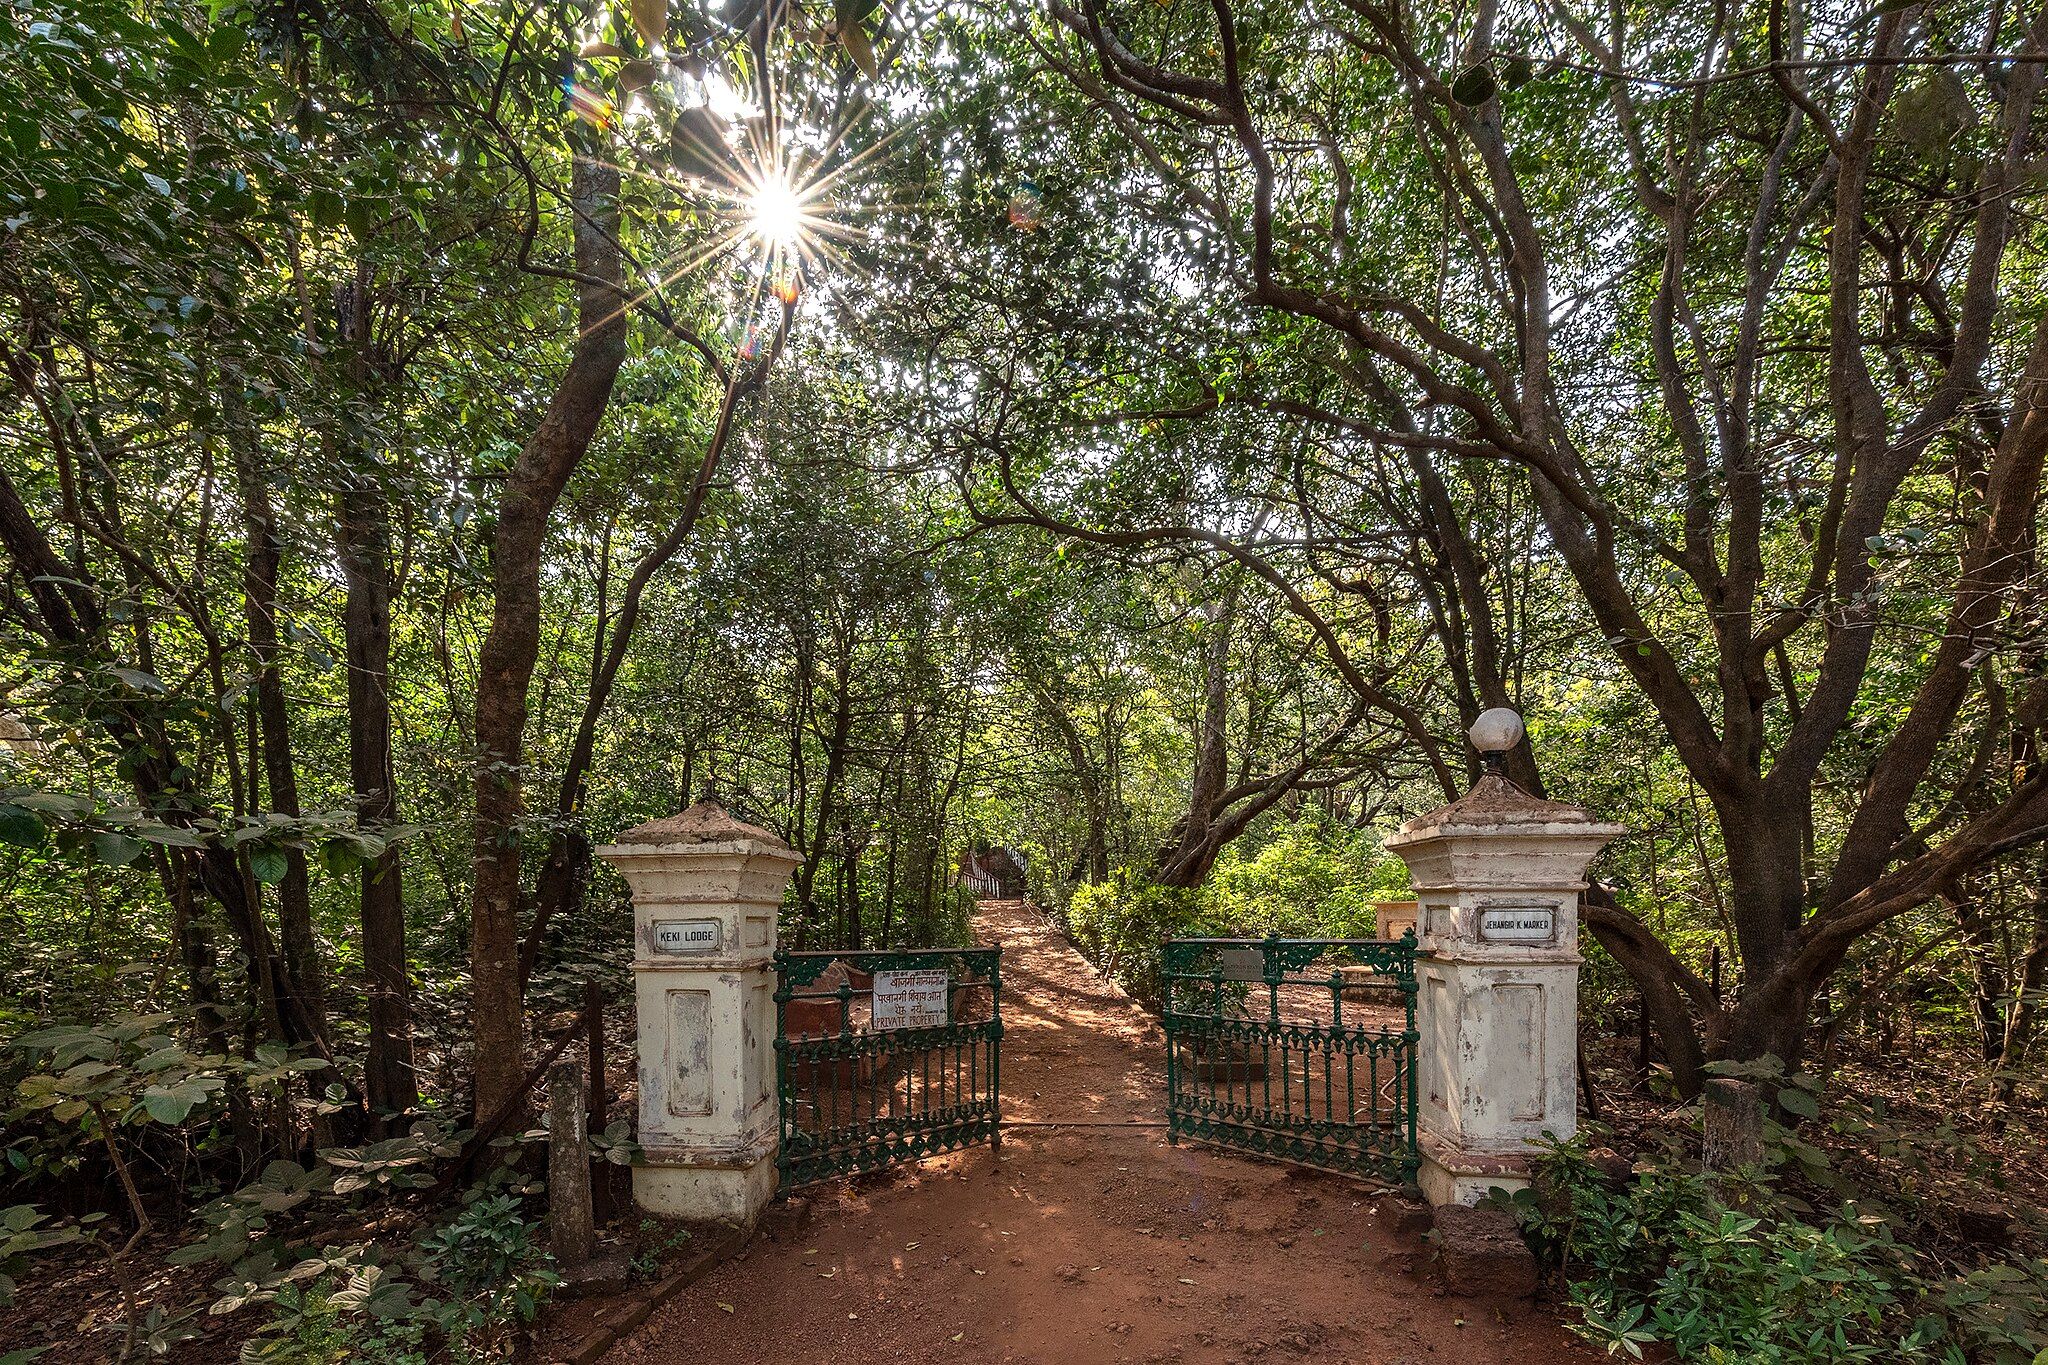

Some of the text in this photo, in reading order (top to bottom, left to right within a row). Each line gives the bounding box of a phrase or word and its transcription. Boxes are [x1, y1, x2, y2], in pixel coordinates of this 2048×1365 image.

[1485, 921, 1515, 930] JEHANGIR
[1523, 921, 1549, 930] MARKER
[660, 930, 714, 942] KEKI LODGE
[877, 1014, 940, 1028] PRIVATE PROPERTY
